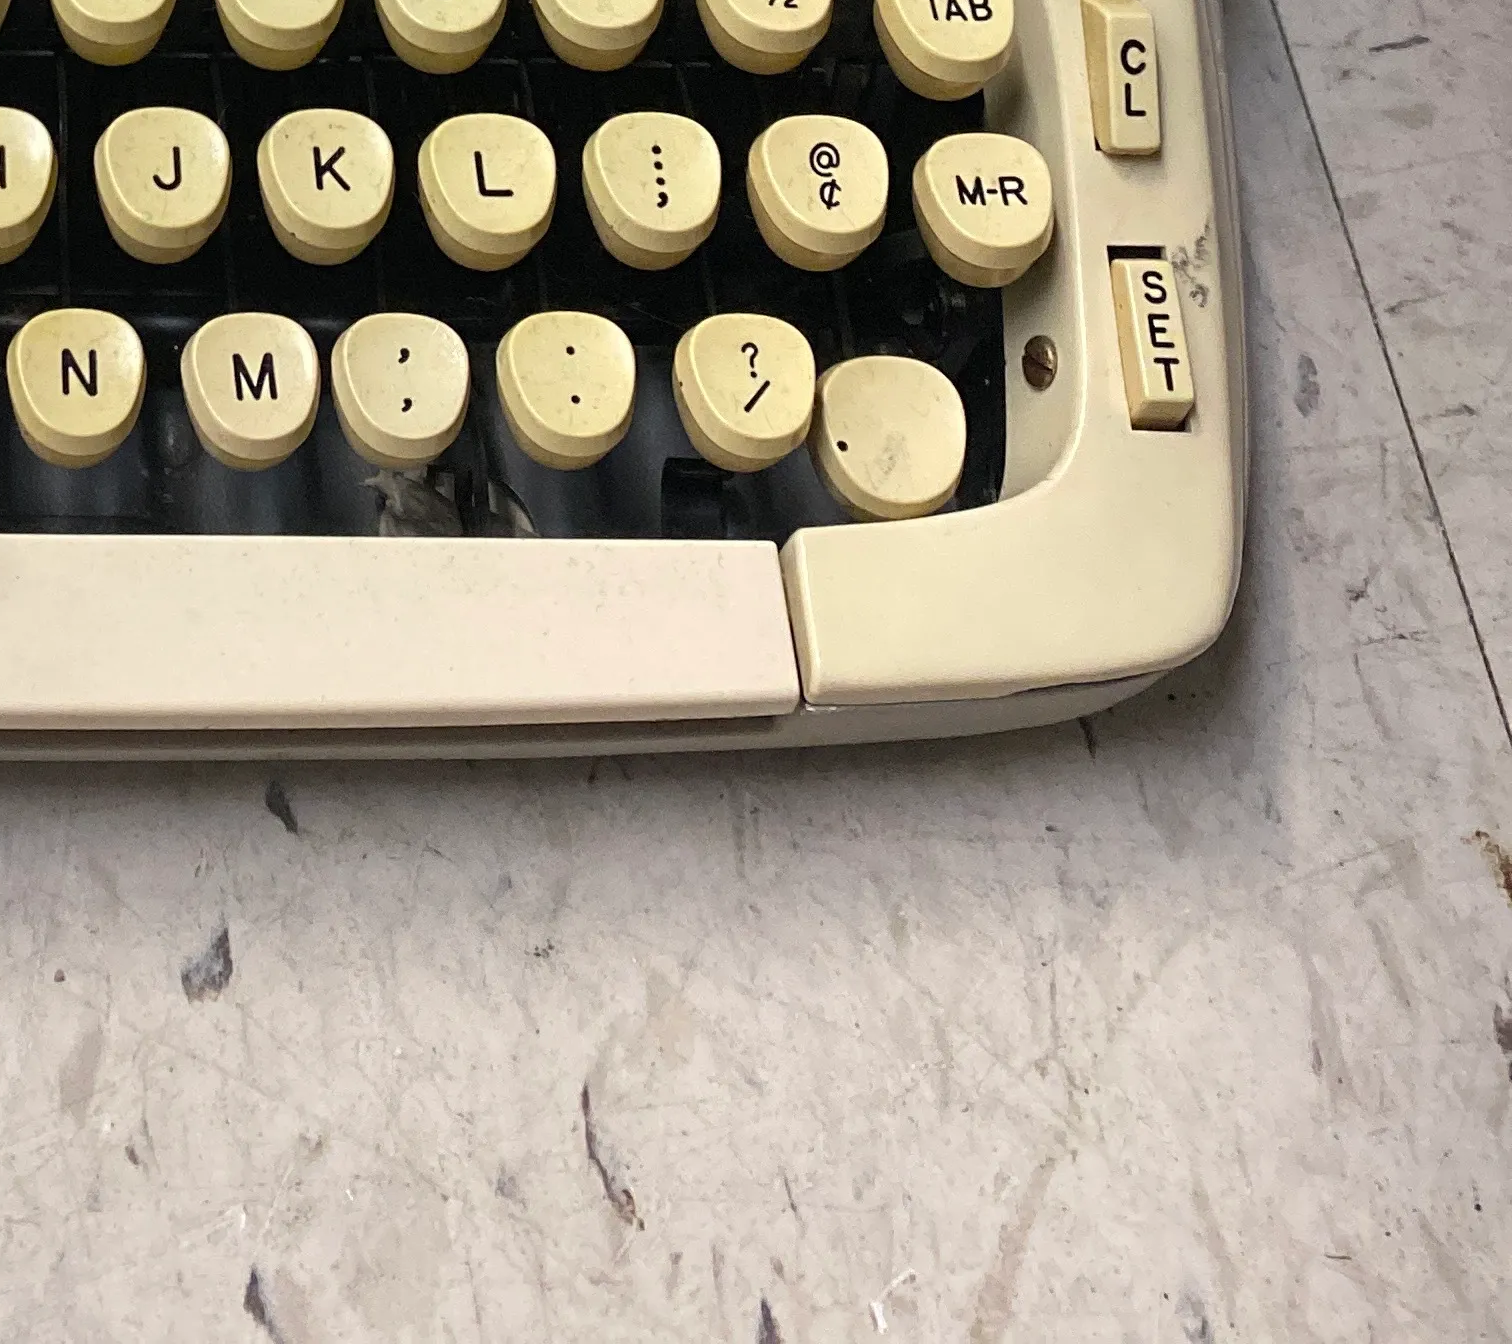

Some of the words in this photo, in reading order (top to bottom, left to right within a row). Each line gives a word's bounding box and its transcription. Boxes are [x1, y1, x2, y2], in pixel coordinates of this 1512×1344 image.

[1120, 39, 1147, 117] CL
[152, 145, 182, 190] J
[313, 145, 351, 192] K
[474, 150, 513, 197] L
[809, 142, 841, 177] @
[820, 179, 841, 210] ¢
[955, 175, 1028, 207] M-R
[1142, 270, 1181, 392] SET
[61, 348, 98, 396] N
[232, 353, 279, 401] M
[740, 341, 759, 379] ?
[743, 380, 771, 412] /
